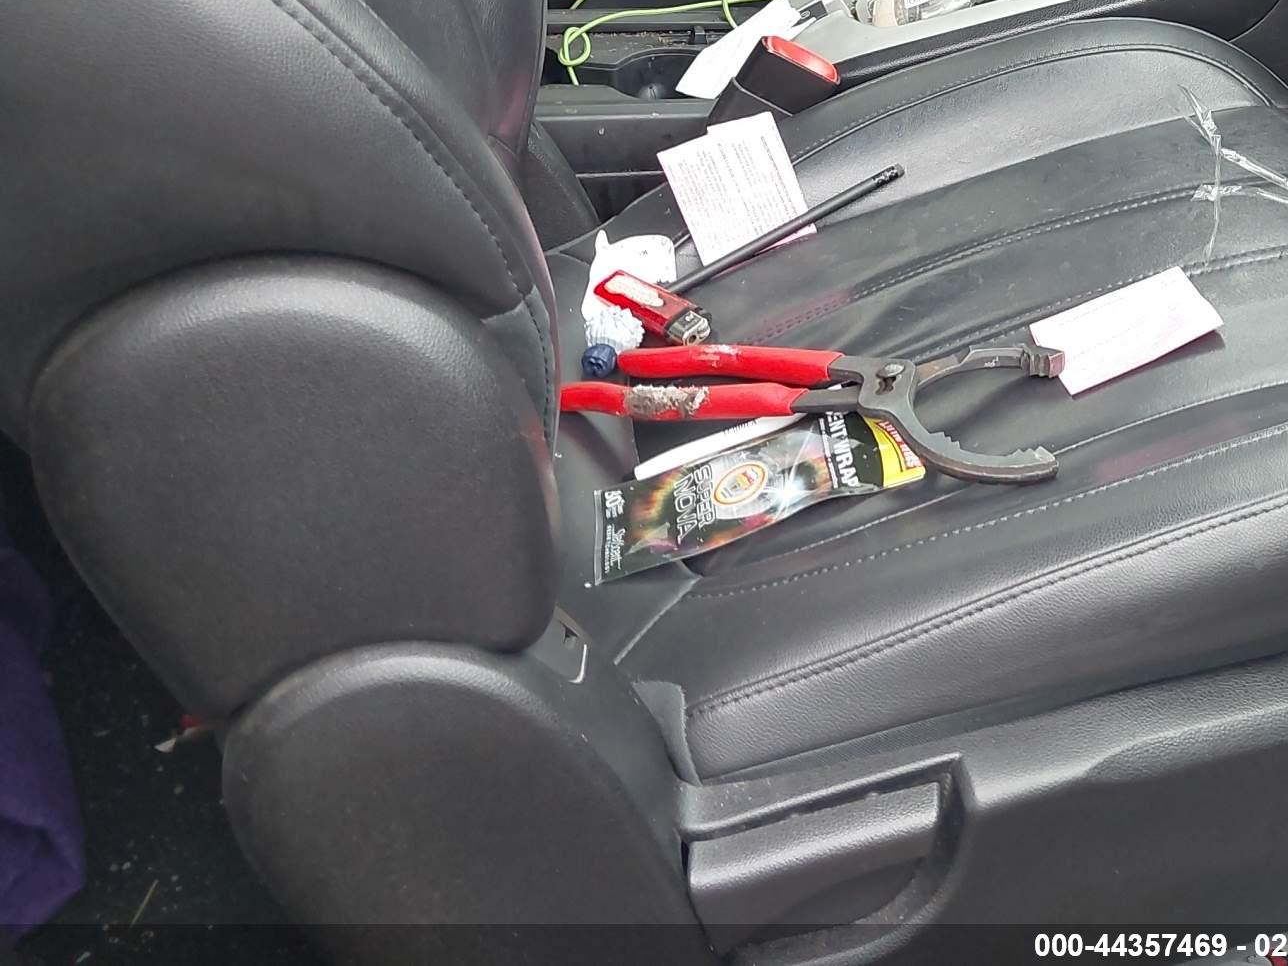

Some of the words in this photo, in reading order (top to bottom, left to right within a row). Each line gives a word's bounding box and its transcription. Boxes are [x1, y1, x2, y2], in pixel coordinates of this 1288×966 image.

[825, 411, 849, 439] ENT
[833, 435, 860, 487] WRAP
[673, 472, 698, 545] NOVA
[694, 464, 717, 531] SUPER
